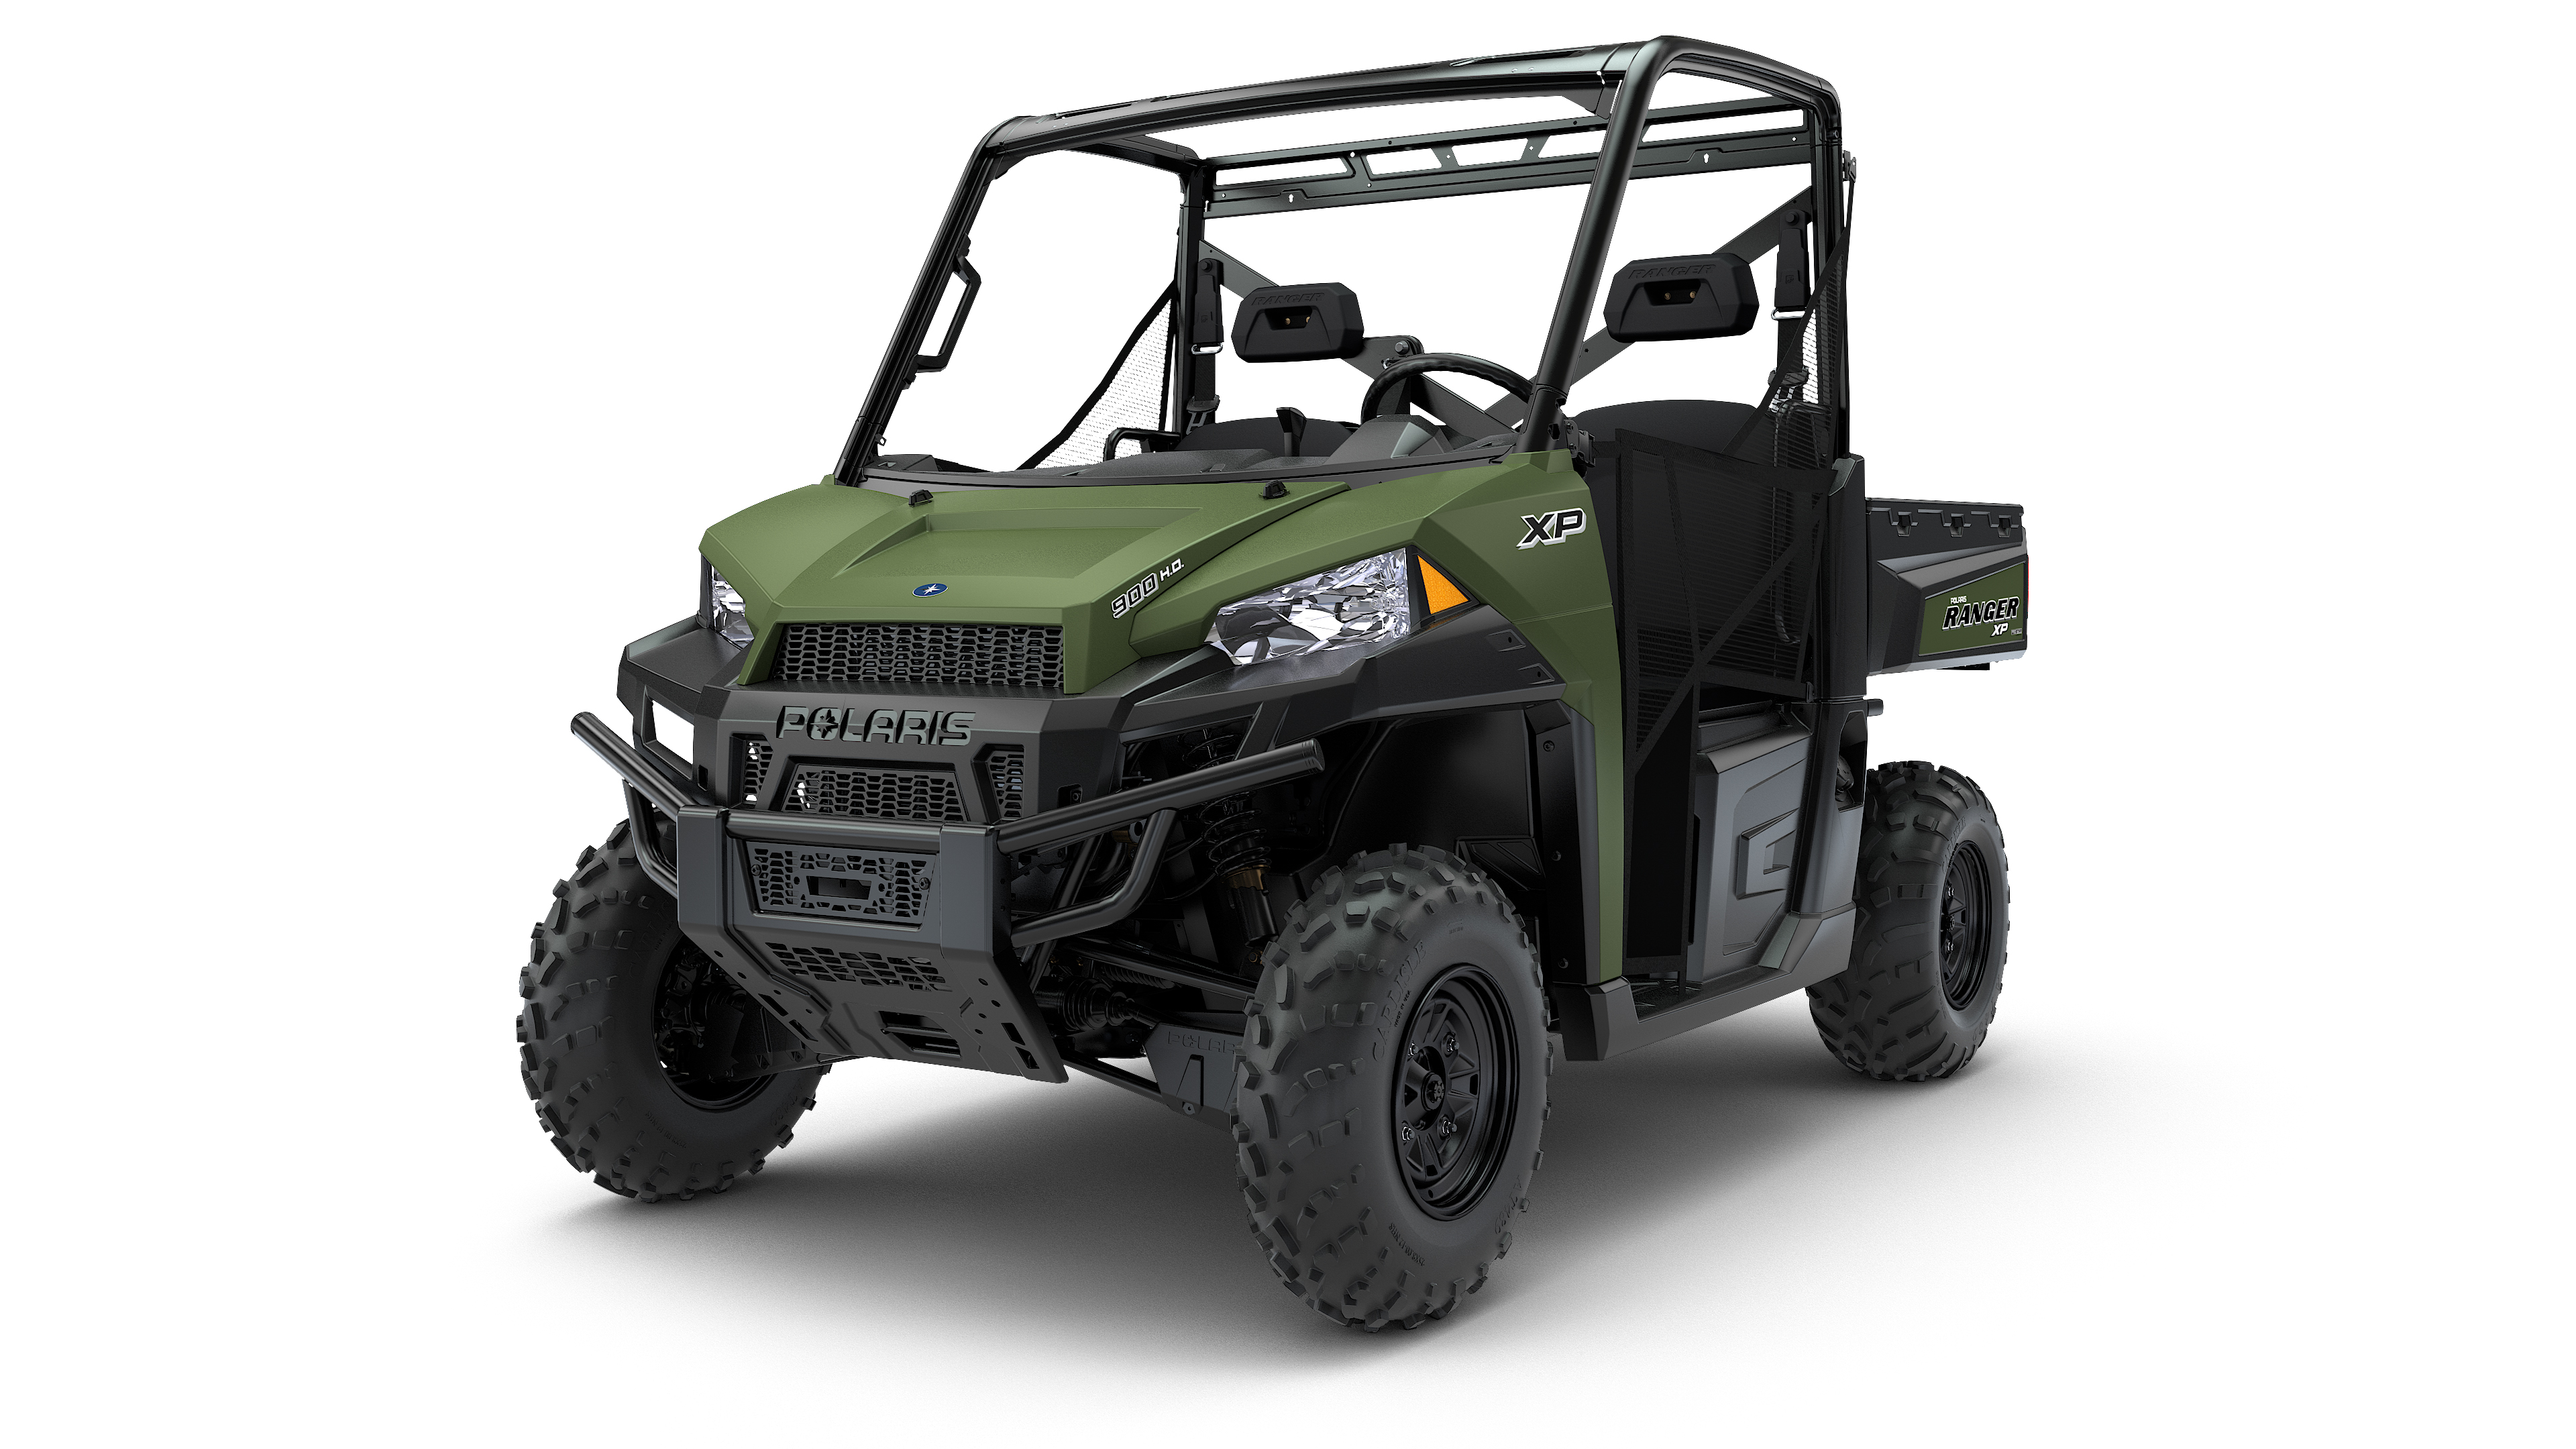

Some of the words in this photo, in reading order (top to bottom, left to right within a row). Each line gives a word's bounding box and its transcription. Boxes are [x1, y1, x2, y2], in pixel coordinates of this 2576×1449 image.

[1628, 264, 1717, 279] RANGER
[1251, 292, 1325, 306] RANGER
[1516, 507, 1587, 550] XP
[1112, 572, 1159, 619] 900
[1159, 558, 1185, 582] H.O.
[1950, 595, 1967, 604] POLARIS
[1942, 596, 2020, 631] RANGER
[1990, 622, 2009, 637] XP
[775, 706, 976, 746] POLARIS
[1373, 939, 1426, 1062] CARLISLE
[1168, 1031, 1235, 1055] POLAR
